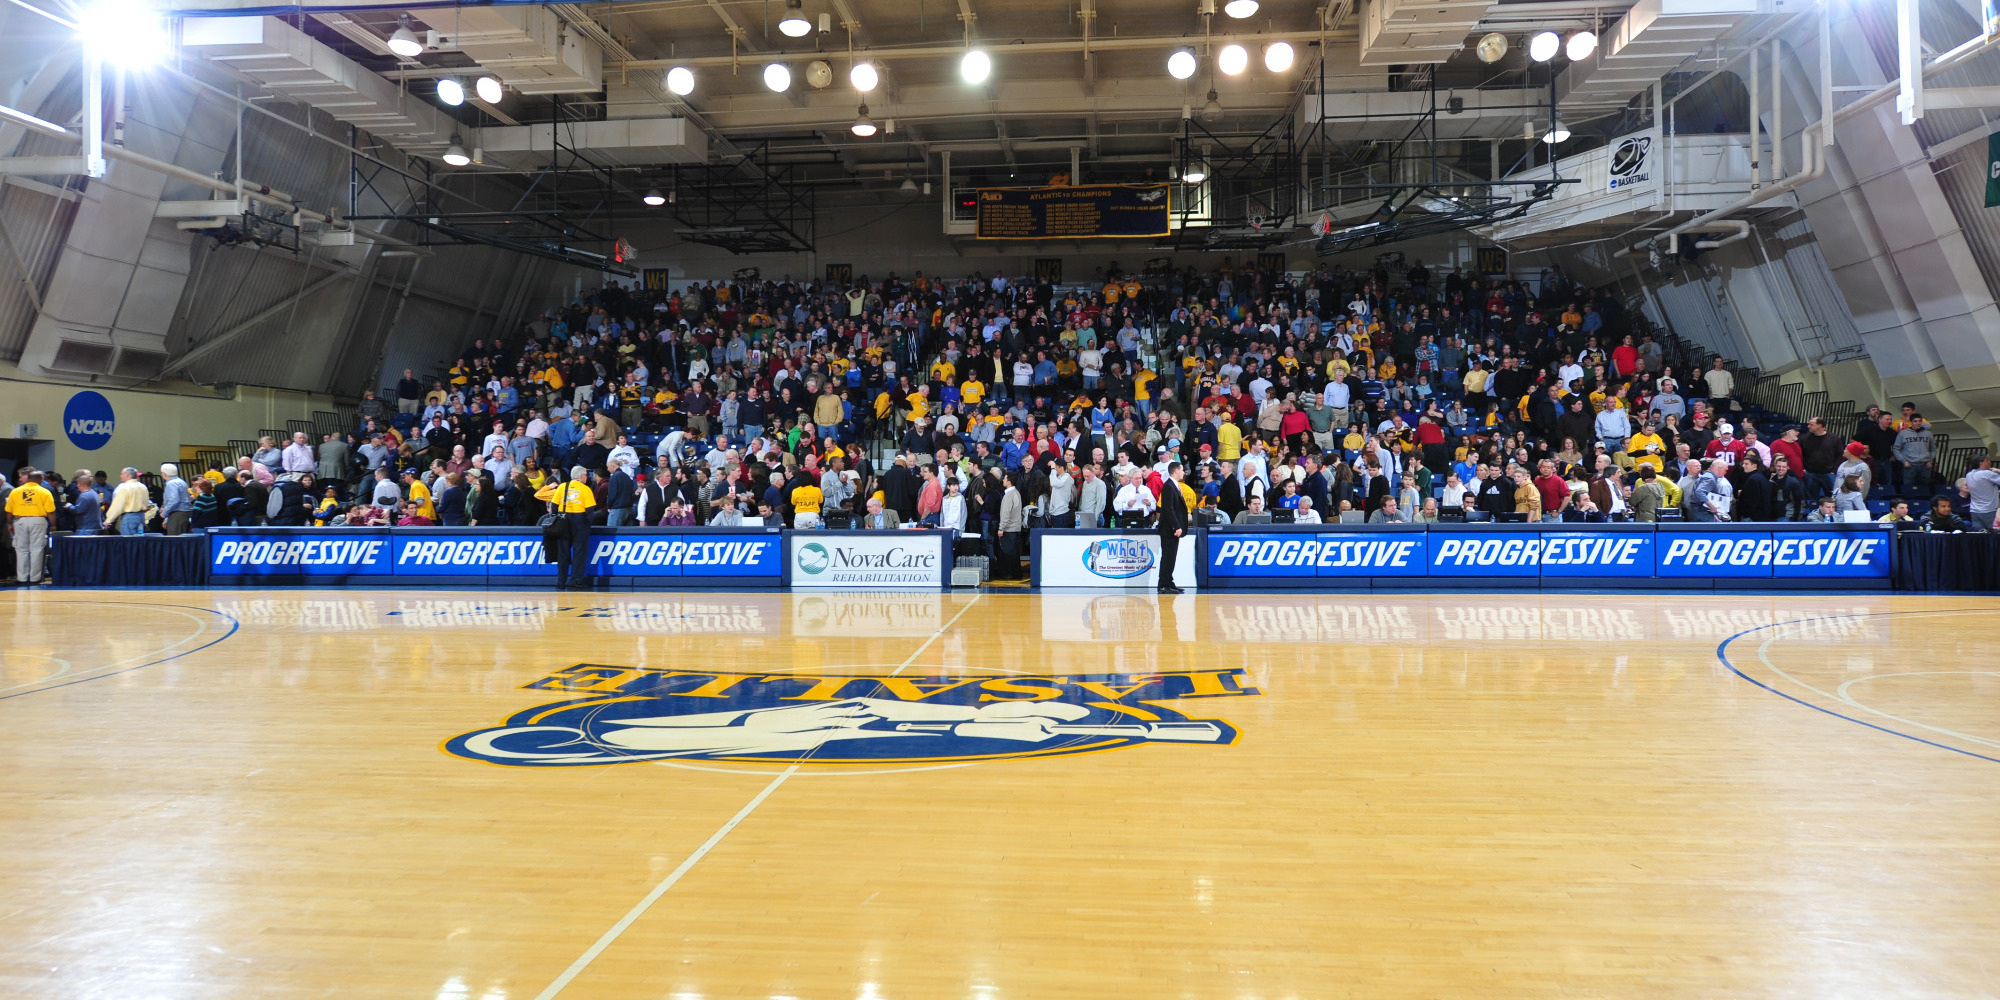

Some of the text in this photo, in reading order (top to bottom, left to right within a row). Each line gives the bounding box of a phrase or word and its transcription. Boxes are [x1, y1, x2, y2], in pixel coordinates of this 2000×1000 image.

[1618, 172, 1650, 187] BASKETBALL
[980, 191, 1003, 202] A10
[1030, 192, 1062, 200] ATLANTIC
[1072, 190, 1112, 199] CHAMPIONS
[1037, 260, 1060, 282] W3
[1480, 250, 1505, 272] W5
[646, 271, 667, 290] W1
[69, 418, 112, 435] NCAA
[215, 540, 385, 565] PROGRESSIVE
[398, 541, 558, 565] PROGRESSI
[590, 541, 767, 565] PROGRESSIVE
[831, 547, 935, 568] NovaCare
[1107, 542, 1146, 557] What
[1214, 540, 1417, 567] PROGRESSIVE
[1434, 538, 1644, 566] PROGRESSIVE
[1663, 538, 1879, 566] PROGRESSIVE
[832, 574, 931, 582] REHABILITATION
[540, 667, 1243, 699] LASALLE
